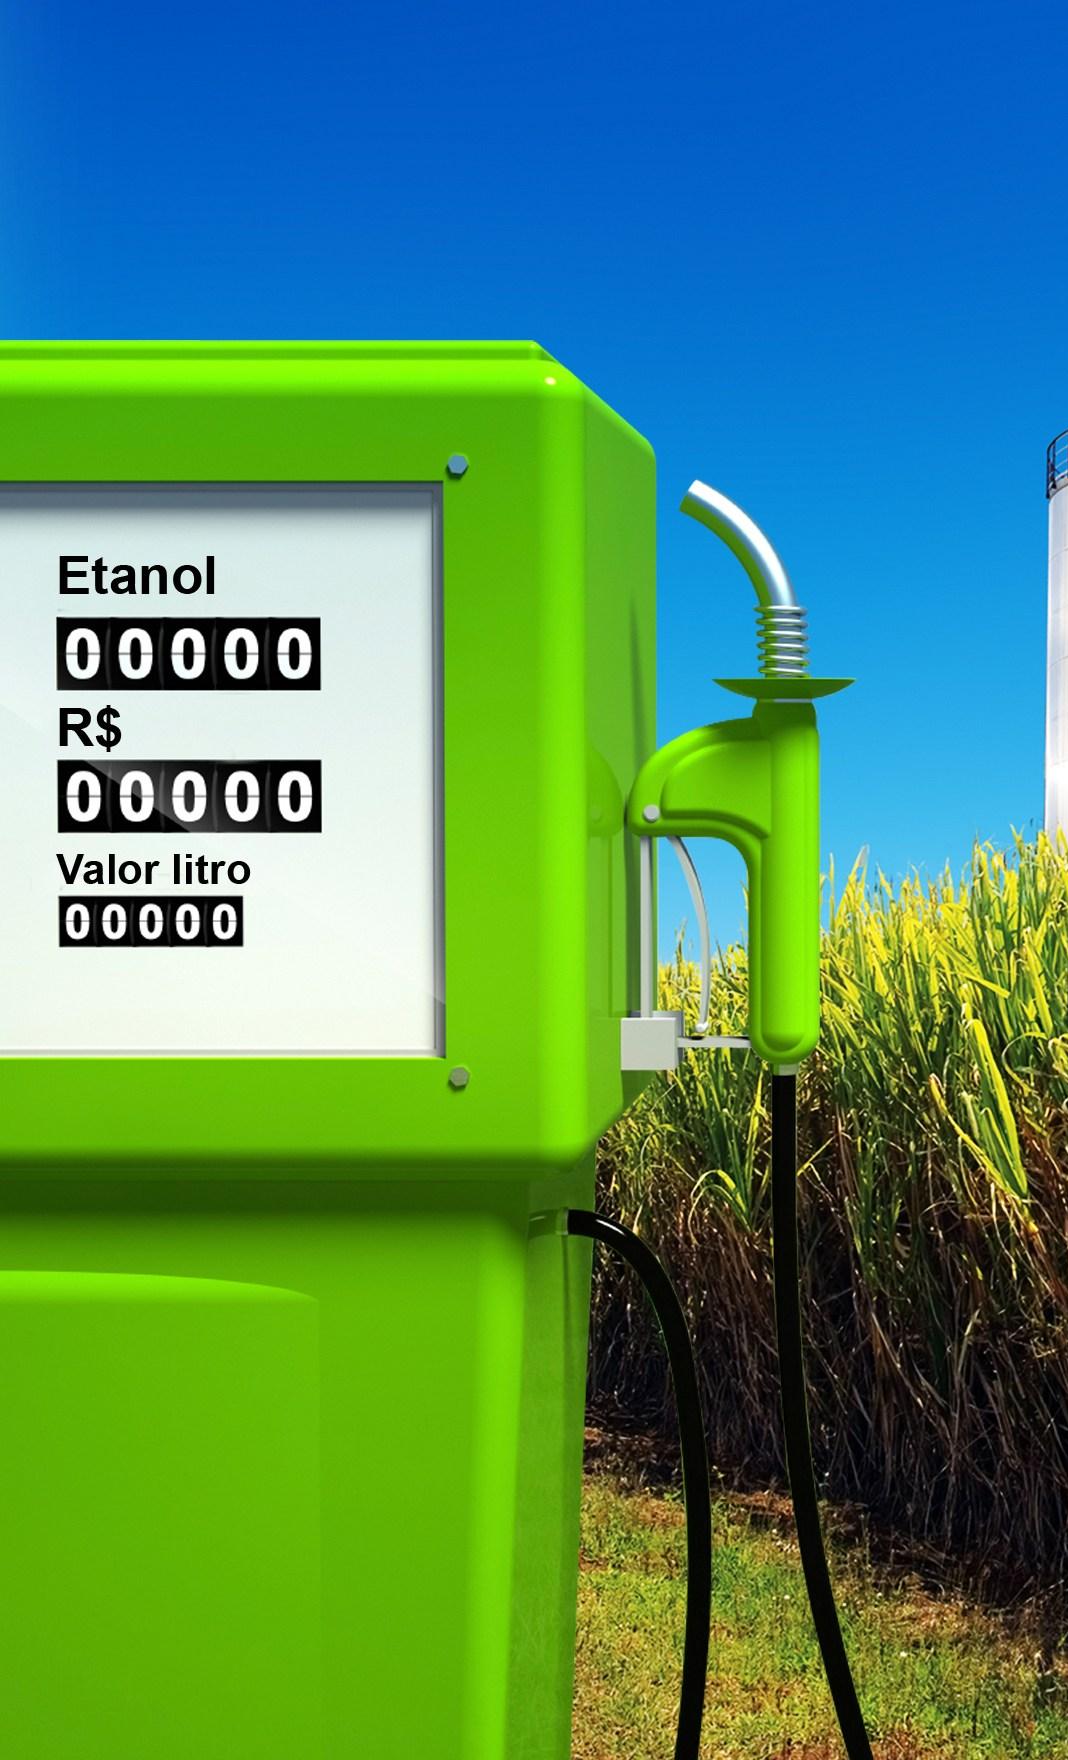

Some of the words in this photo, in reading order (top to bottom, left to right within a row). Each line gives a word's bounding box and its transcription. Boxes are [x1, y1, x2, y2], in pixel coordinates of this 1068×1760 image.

[59, 555, 215, 595] Etanol
[65, 627, 313, 680] 00000
[59, 704, 122, 753] R$
[66, 770, 313, 823] 00000
[56, 853, 161, 885] Valor
[173, 853, 251, 885] litro
[65, 903, 237, 940] 00000
